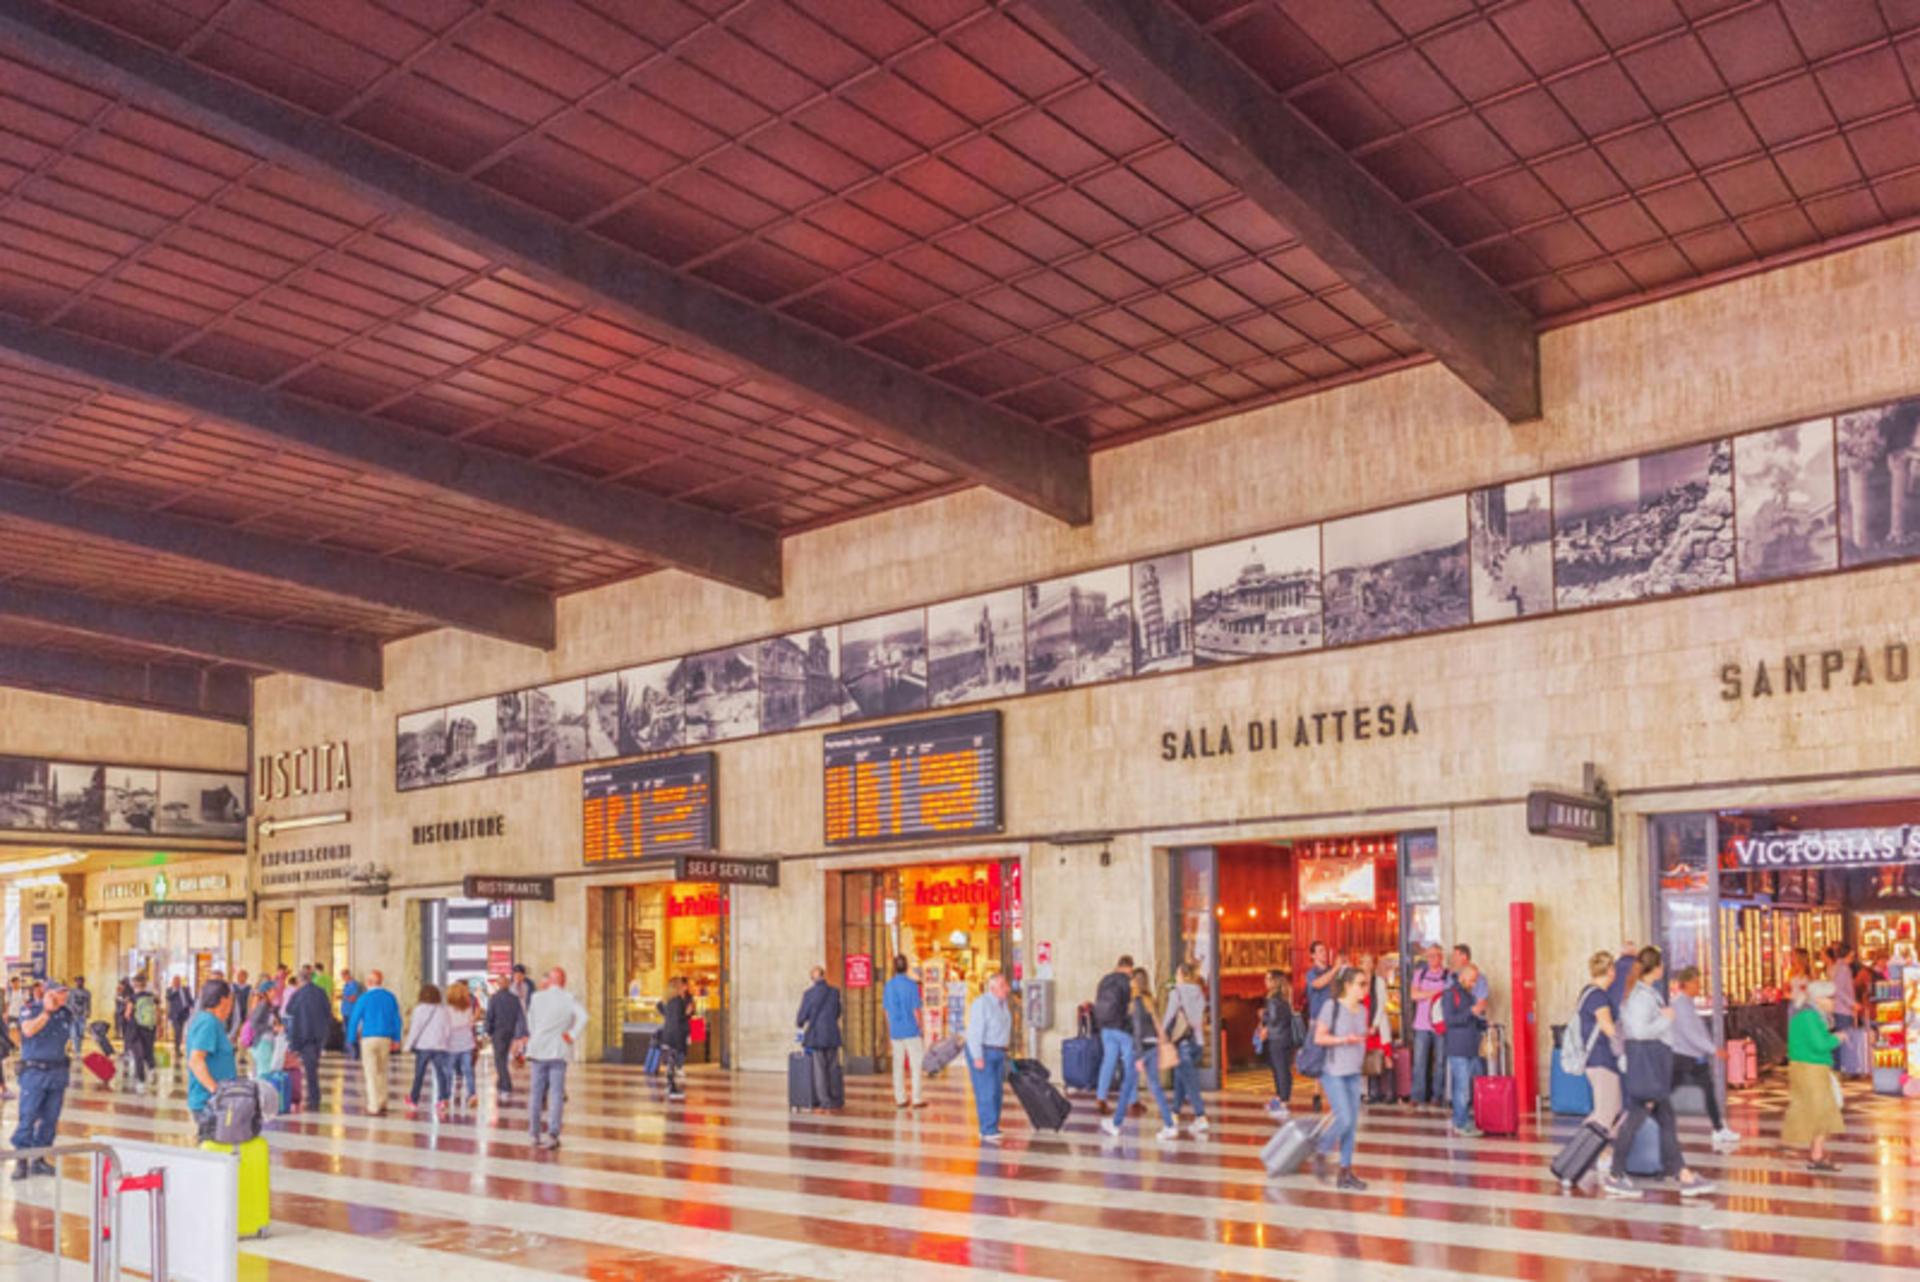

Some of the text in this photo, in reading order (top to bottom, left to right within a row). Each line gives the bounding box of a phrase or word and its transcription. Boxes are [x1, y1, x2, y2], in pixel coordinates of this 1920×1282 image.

[1720, 642, 1910, 700] SANPAO
[1161, 702, 1419, 762] SALA DI ATTESA
[257, 740, 351, 801] USCITA
[687, 861, 769, 879] SELF SERVICE
[1735, 835, 1896, 865] VICTORIA'S
